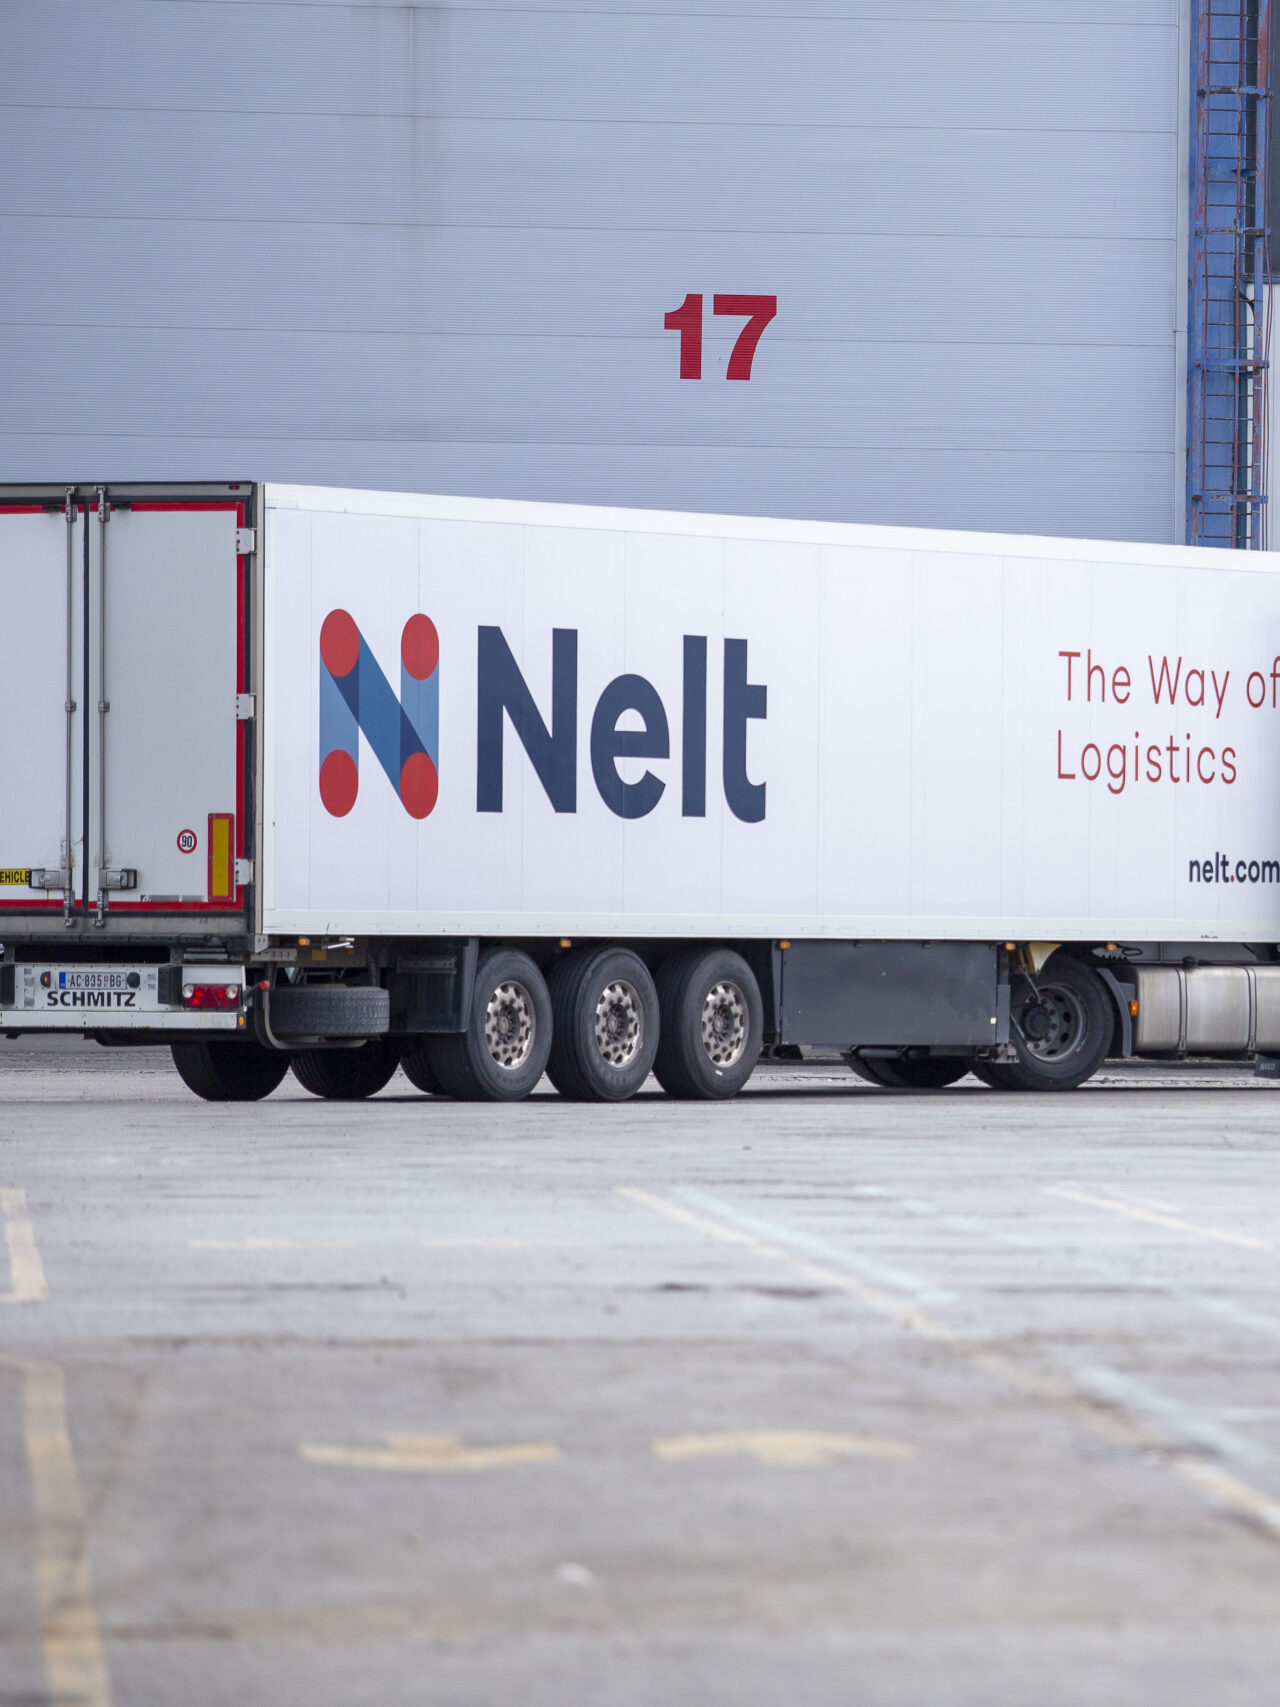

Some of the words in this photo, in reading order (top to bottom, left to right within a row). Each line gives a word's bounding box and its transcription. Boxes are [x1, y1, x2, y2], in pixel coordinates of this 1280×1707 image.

[664, 293, 777, 380] 17
[1058, 649, 1131, 704] The
[1147, 655, 1230, 719] Way
[476, 624, 768, 824] Nelt
[1057, 729, 1237, 794] Logistics
[181, 835, 193, 848] 90
[1188, 851, 1280, 883] nelt.com
[47, 991, 136, 1007] SCHMITZ
[109, 974, 122, 988] BG
